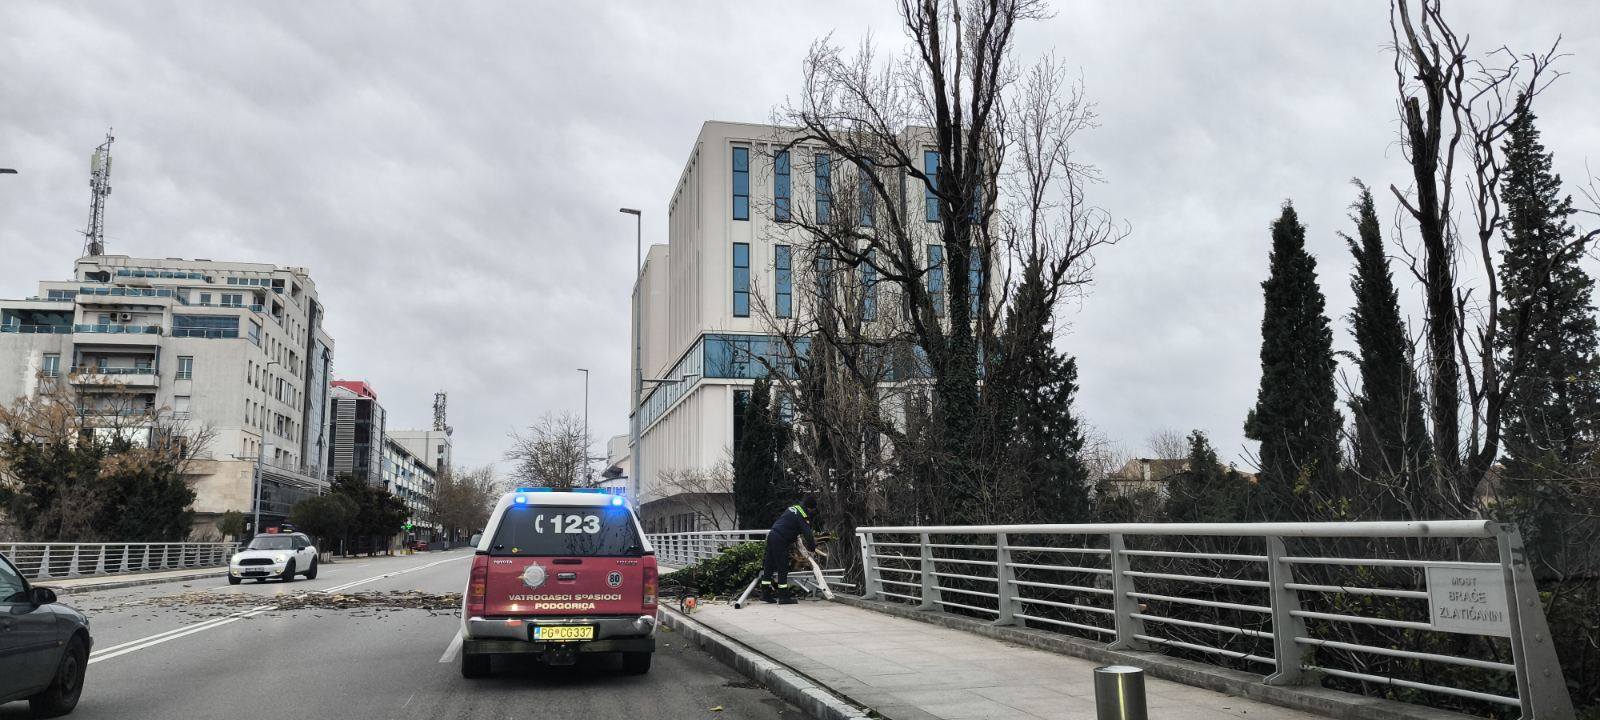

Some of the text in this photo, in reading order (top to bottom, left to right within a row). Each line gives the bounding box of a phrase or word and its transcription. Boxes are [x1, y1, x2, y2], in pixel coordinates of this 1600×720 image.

[550, 514, 600, 534] 123
[609, 574, 620, 583] 80
[1451, 576, 1477, 587] MOST
[508, 593, 622, 601] VATROGASCI SPASIOCI
[534, 602, 595, 610] PODGORICA
